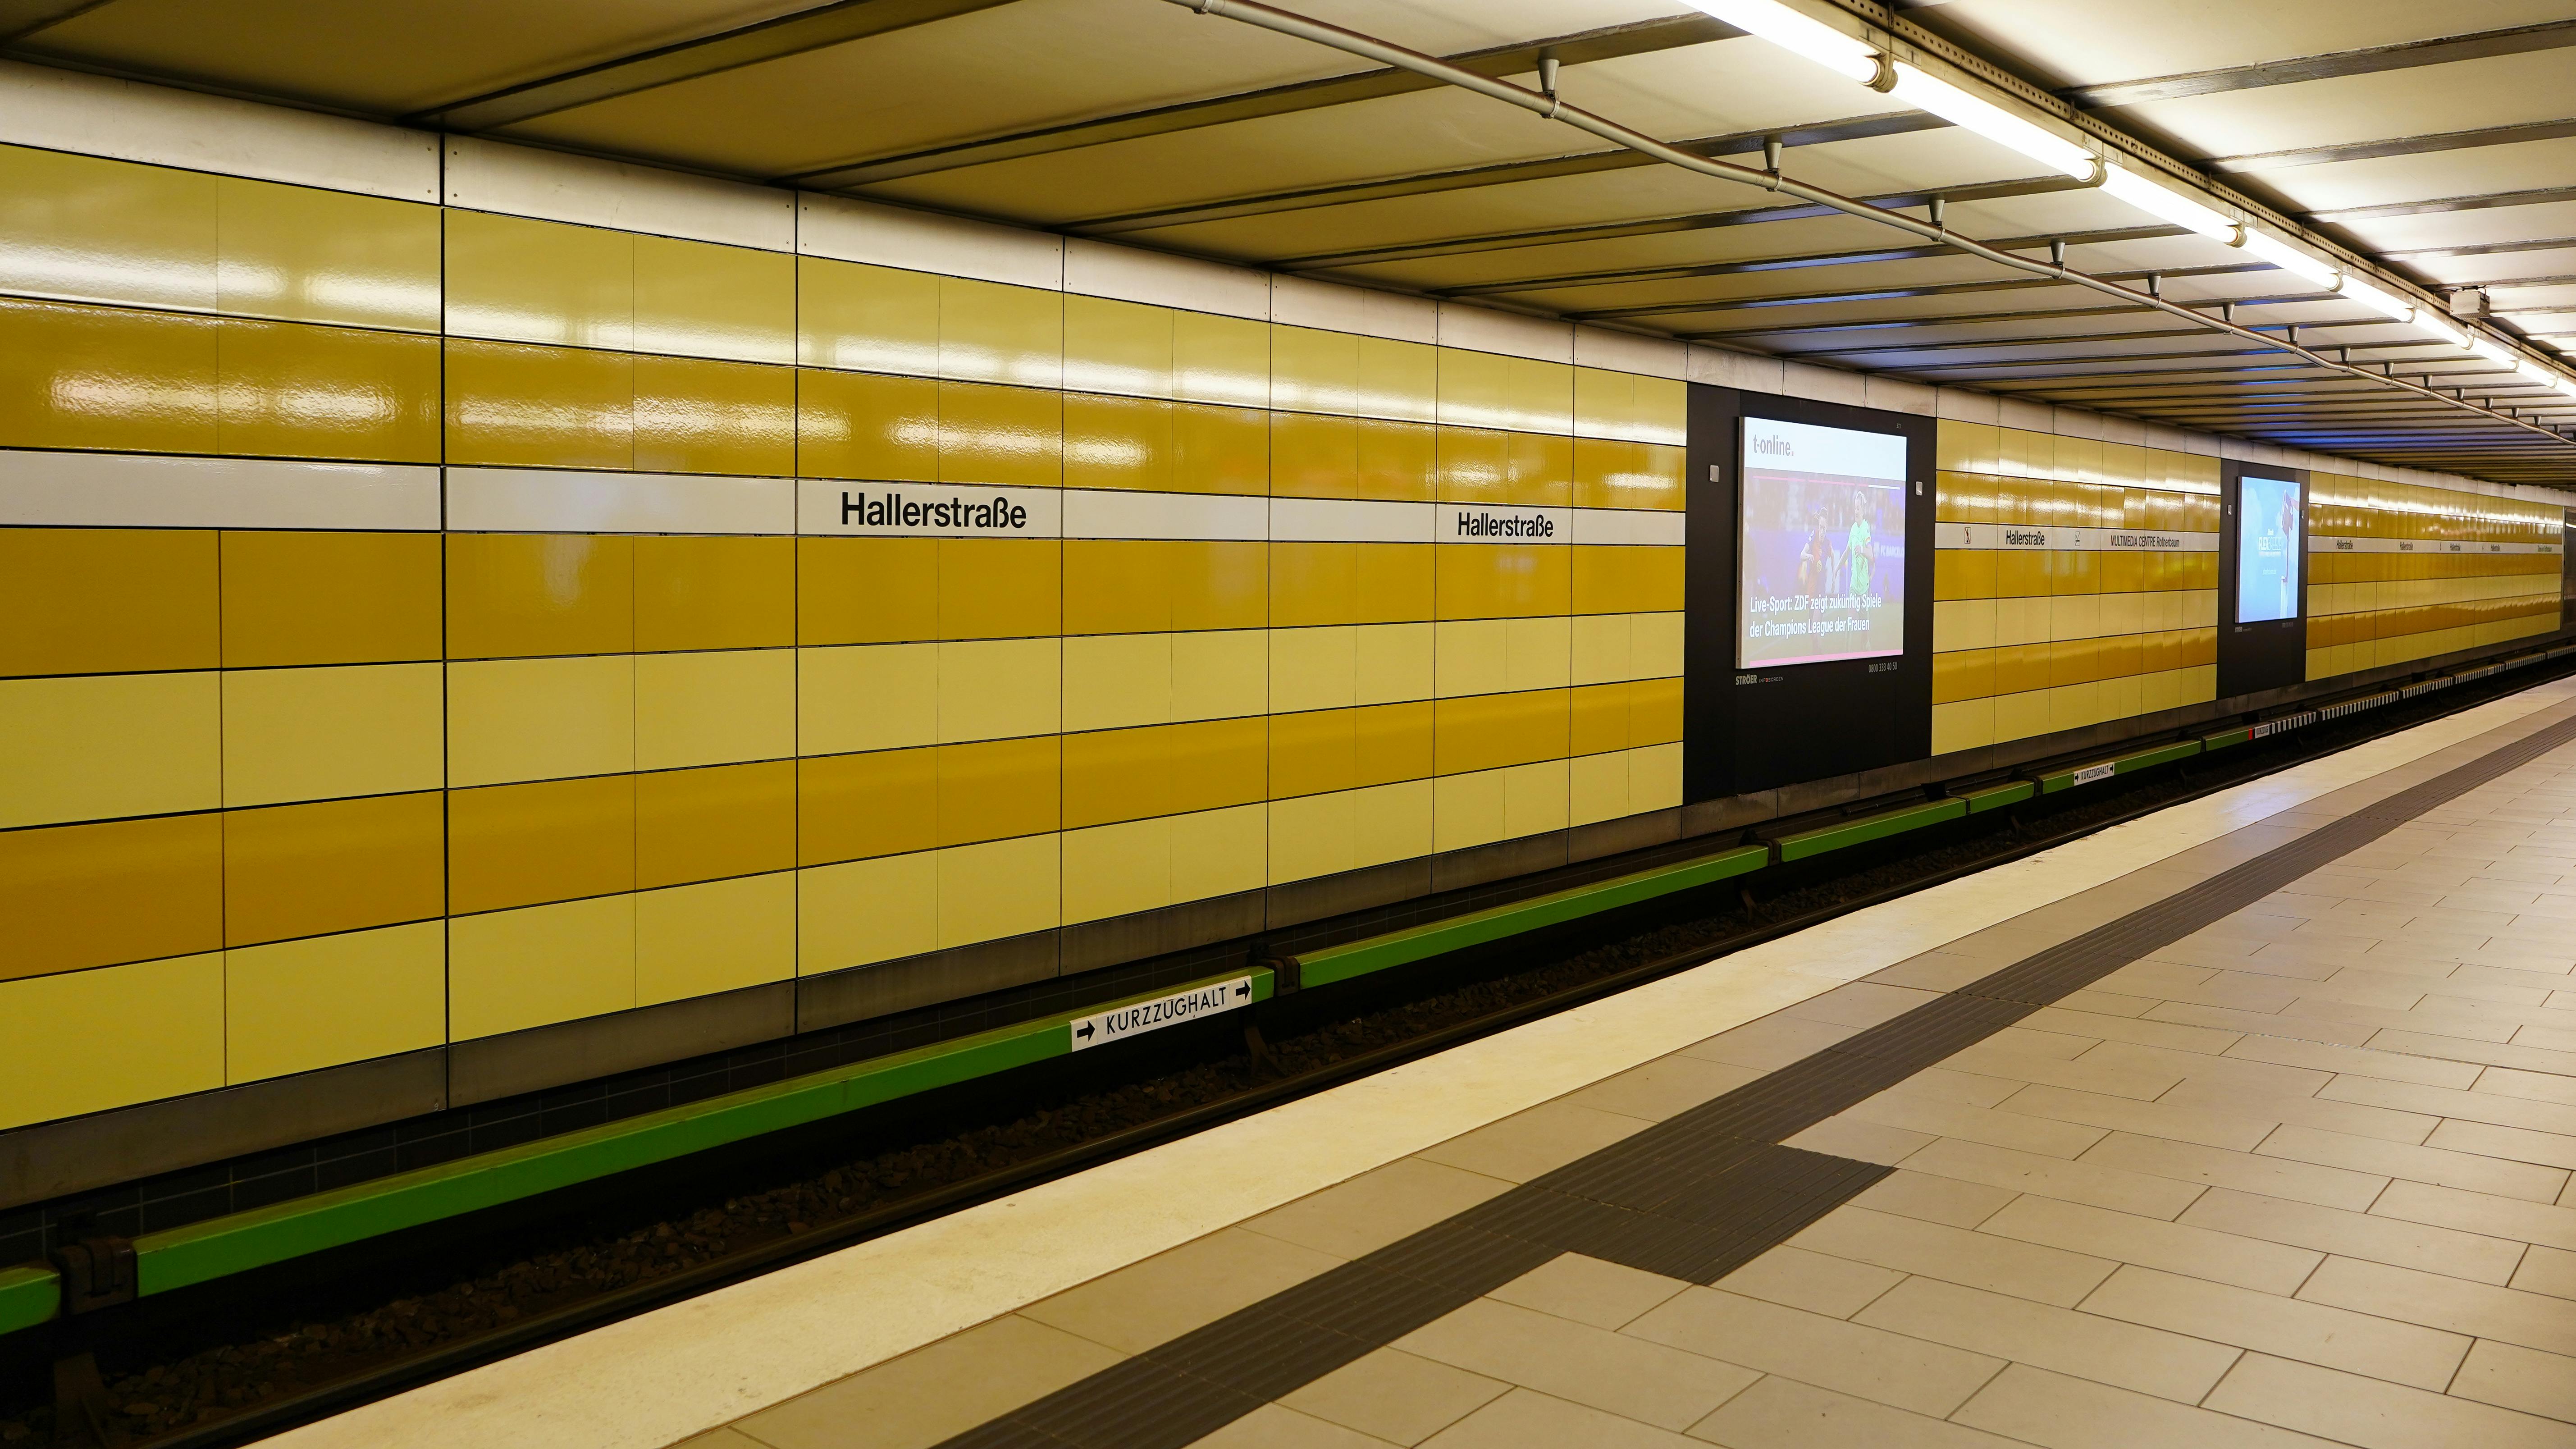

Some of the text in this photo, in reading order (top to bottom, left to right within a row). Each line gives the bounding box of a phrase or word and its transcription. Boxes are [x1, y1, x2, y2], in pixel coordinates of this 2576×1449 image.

[1753, 434, 1794, 457] t-online.
[841, 492, 1027, 529] Hallerstraße
[1458, 512, 1553, 537] Hallerstraße
[2006, 530, 2045, 546] Hallerstraße
[2110, 535, 2138, 547] MULTIMEDIA
[2138, 536, 2156, 547] CENTRE
[1750, 593, 1882, 615] Live-Sport: ZDF zeigt zukünftig Spiele
[1749, 616, 1870, 639] der Champions League der Frauen
[1868, 663, 1878, 672] 0800
[1886, 662, 1892, 671] 40
[1892, 662, 1898, 670] 50
[1736, 674, 1757, 686] STRÖER
[2081, 765, 2109, 780] KURZZUGHALT
[1106, 986, 1226, 1034] KURZZUGHALT
